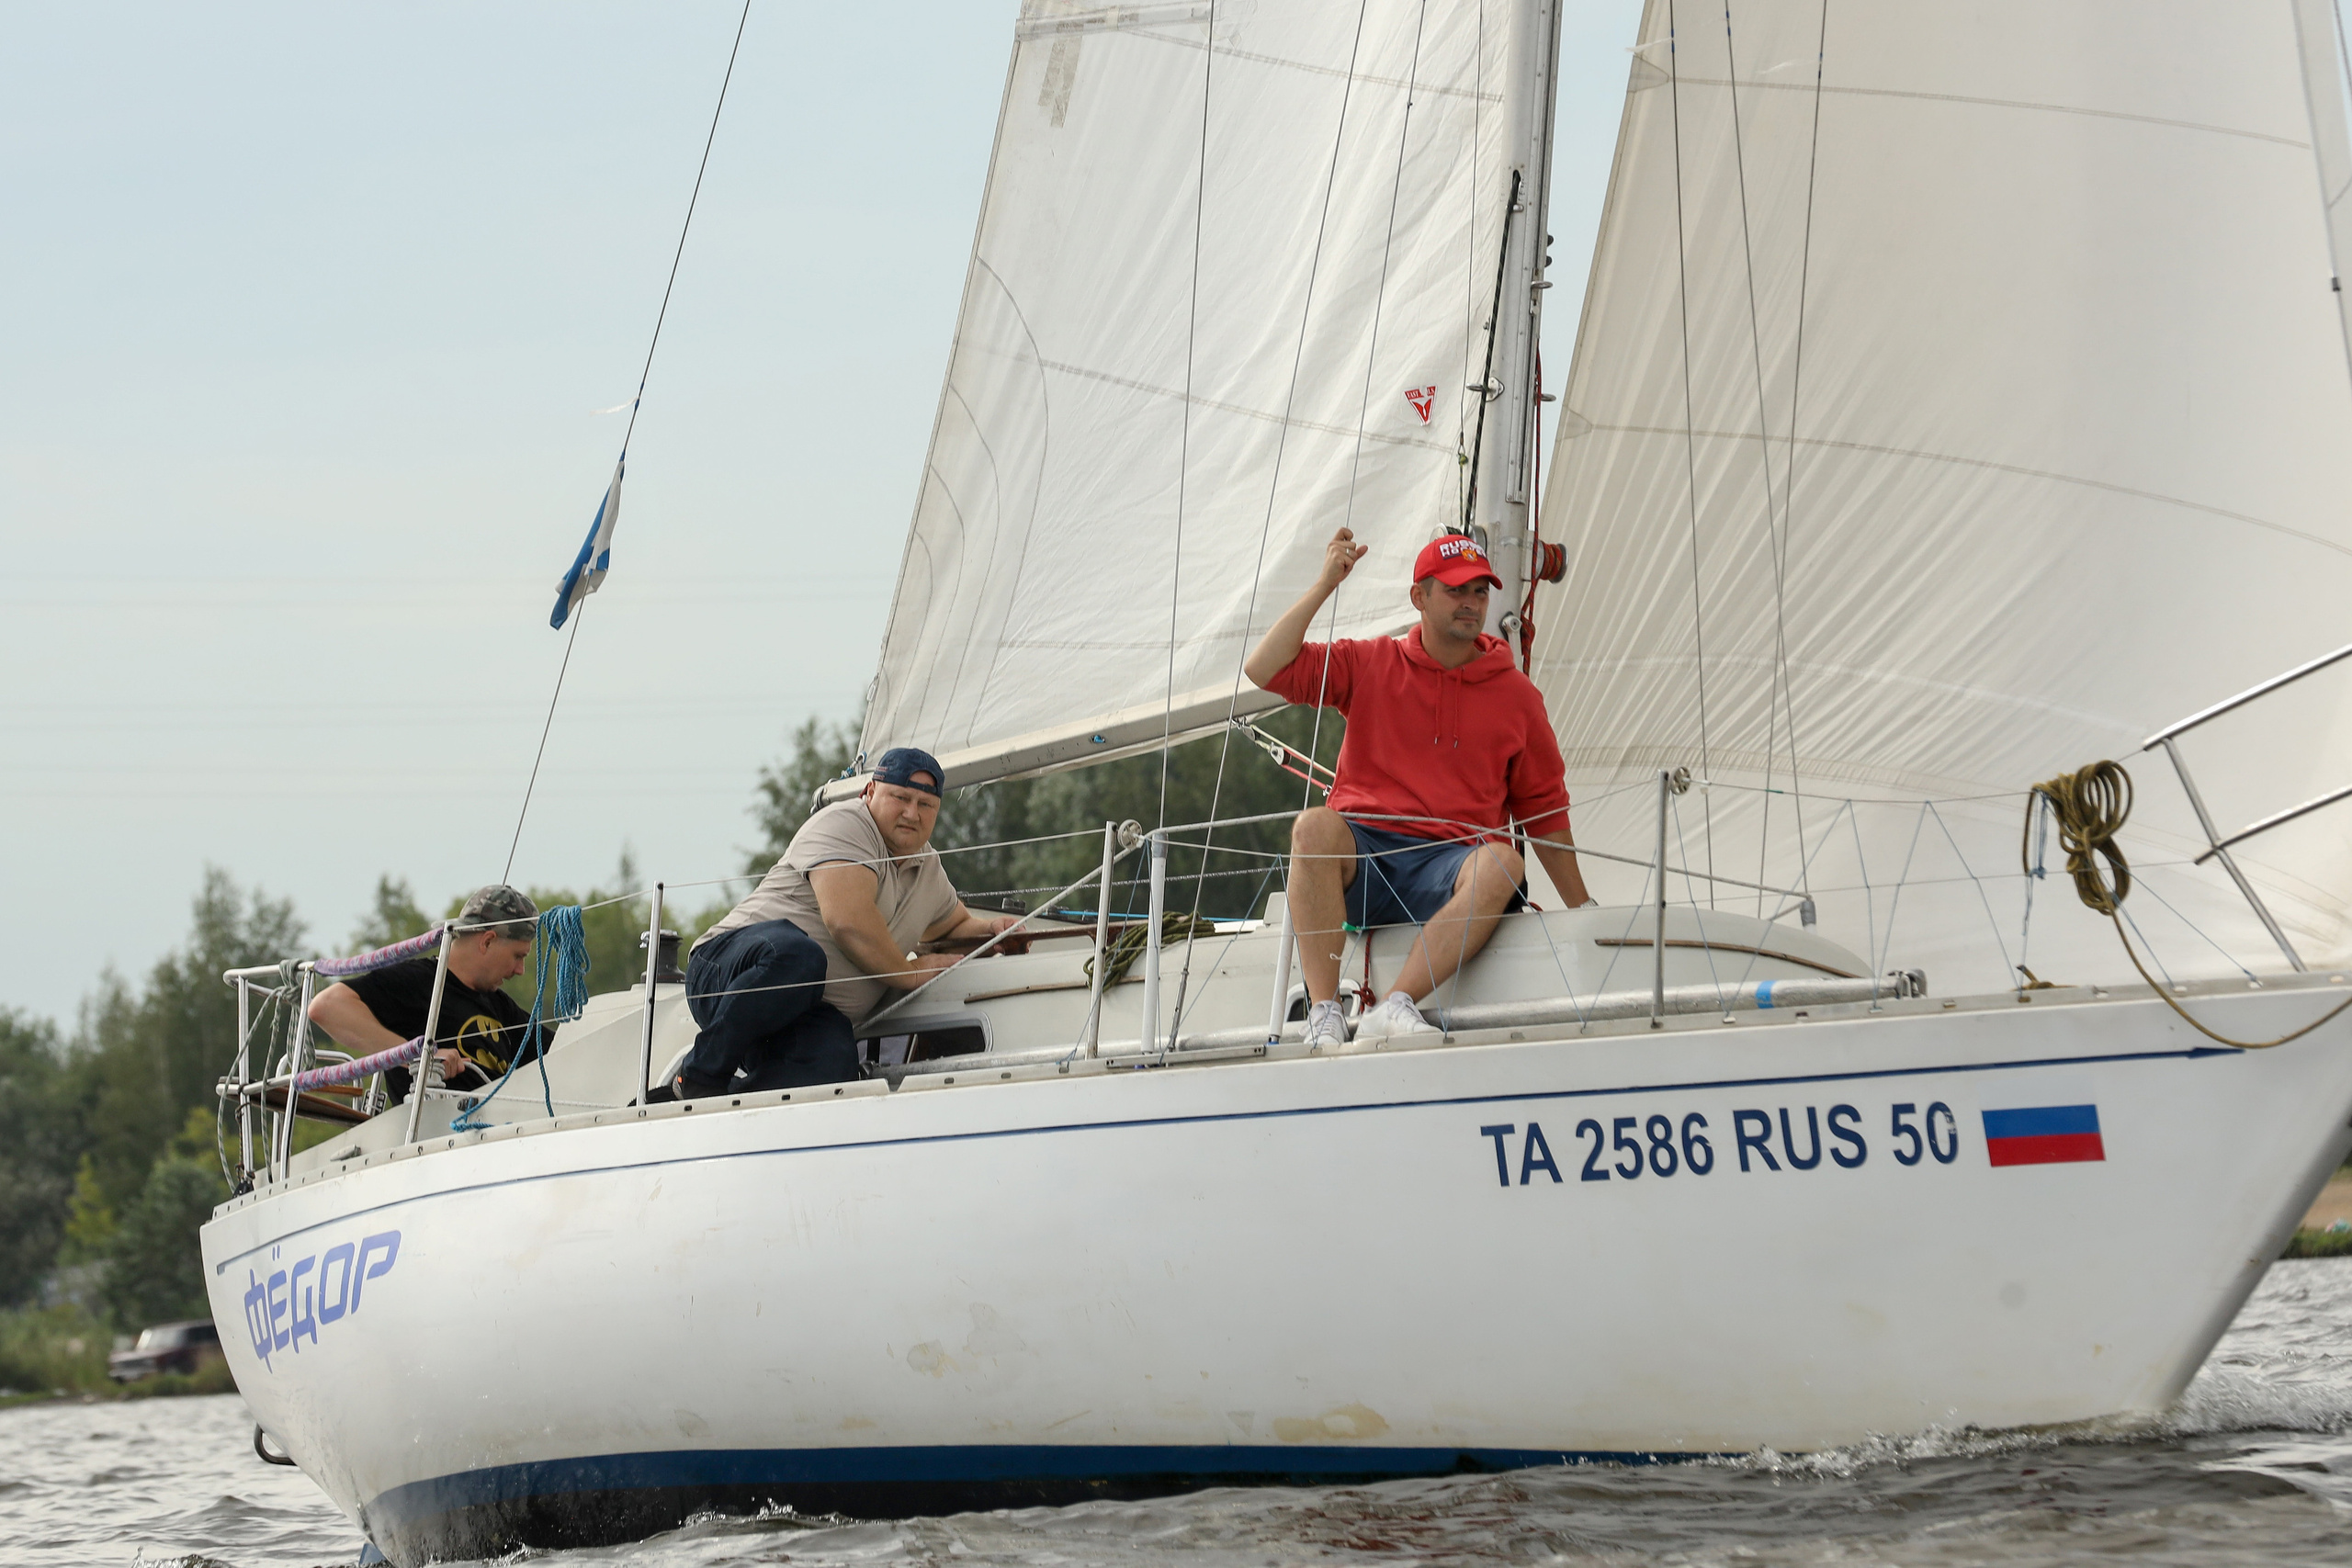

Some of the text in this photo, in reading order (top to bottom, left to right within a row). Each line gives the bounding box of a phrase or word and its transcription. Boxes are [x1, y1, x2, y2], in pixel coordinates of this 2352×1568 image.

[1481, 1101, 1959, 1187] TA 2586 RUS 50
[244, 1230, 401, 1374] ФЁДОР
